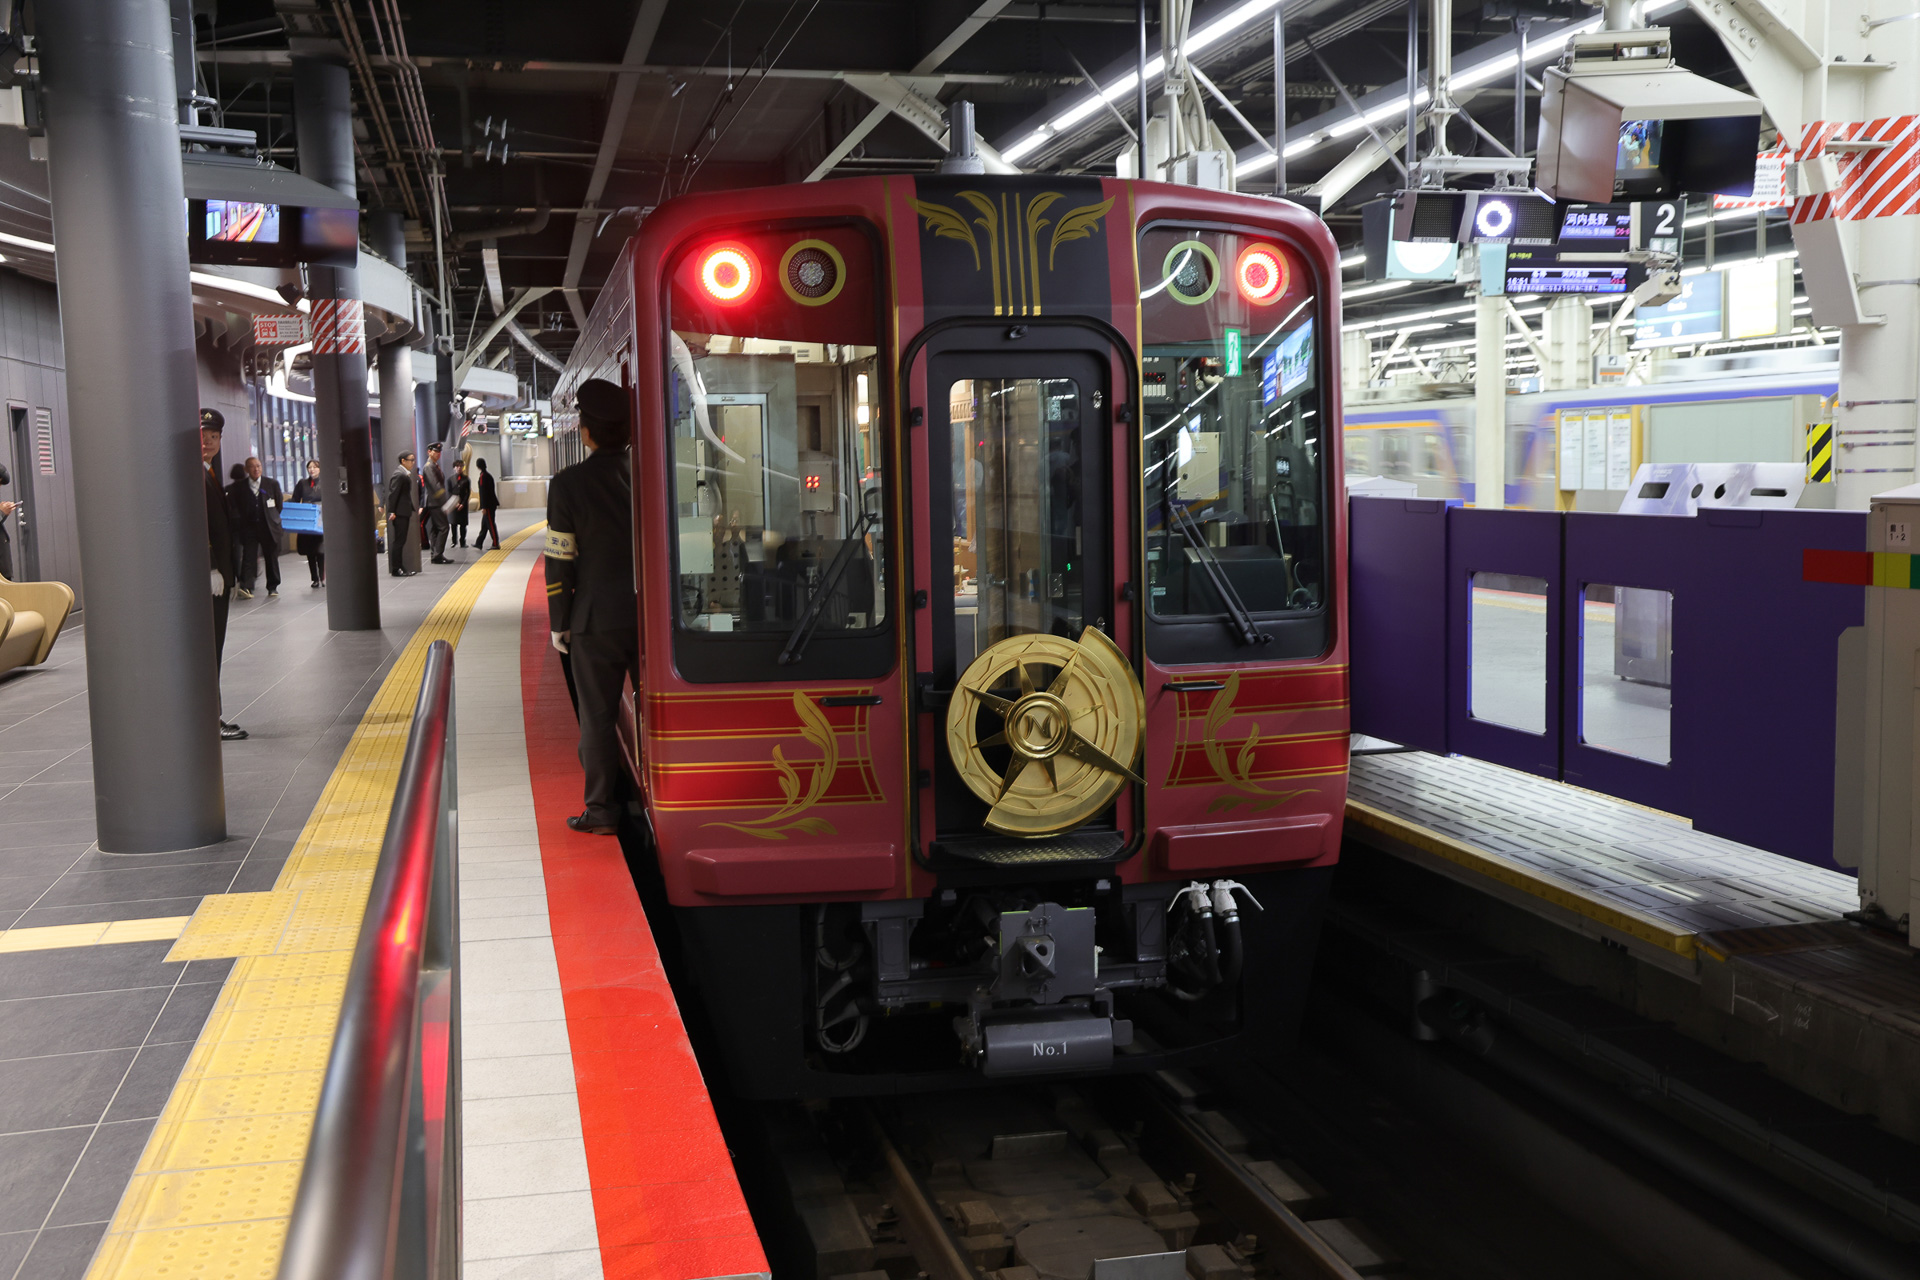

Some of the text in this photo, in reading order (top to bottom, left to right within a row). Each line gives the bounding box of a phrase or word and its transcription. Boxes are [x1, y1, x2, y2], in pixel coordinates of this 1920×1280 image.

[1565, 213, 1608, 226] 河内長野
[1654, 203, 1676, 235] 2
[1033, 1041, 1067, 1056] No.1
